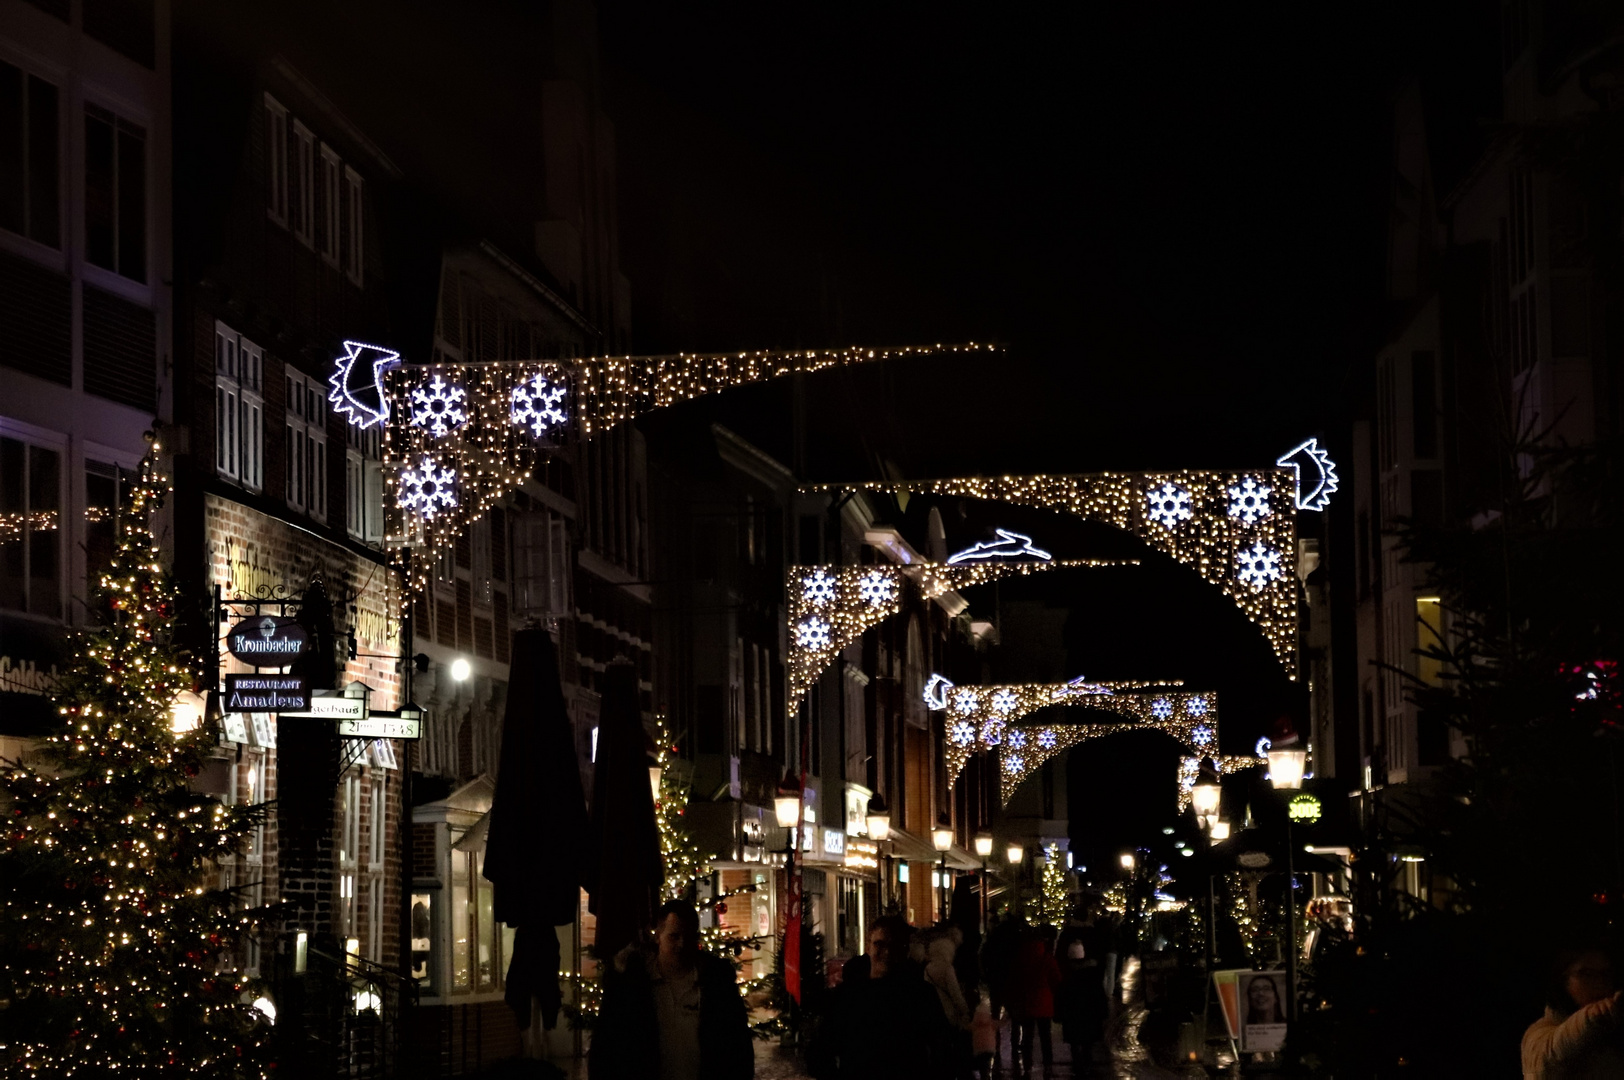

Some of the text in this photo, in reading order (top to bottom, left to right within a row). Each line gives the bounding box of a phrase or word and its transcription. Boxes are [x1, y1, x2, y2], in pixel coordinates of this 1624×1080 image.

[234, 635, 302, 653] Krombacher
[235, 680, 302, 690] RESTAURANT
[230, 691, 305, 709] Amadeus
